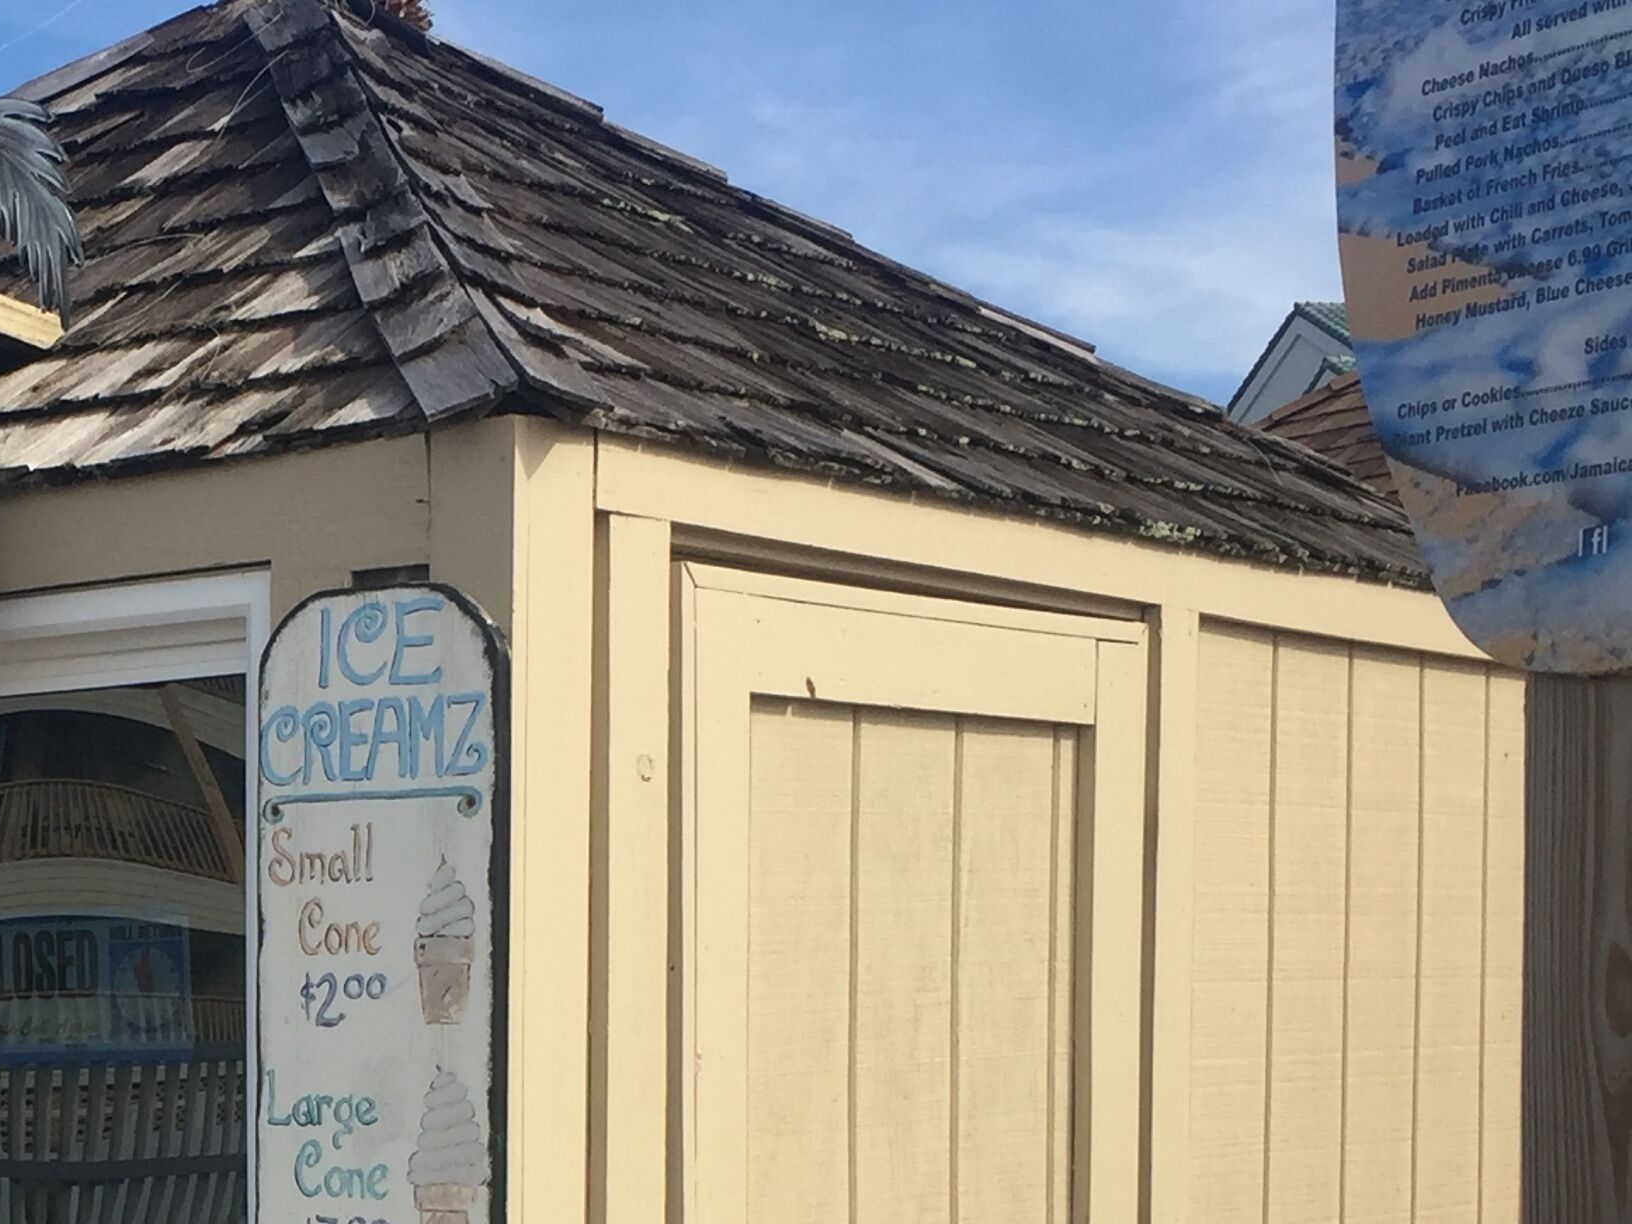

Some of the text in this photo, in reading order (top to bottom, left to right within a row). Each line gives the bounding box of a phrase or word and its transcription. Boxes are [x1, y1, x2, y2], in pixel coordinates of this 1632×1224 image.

[1460, 2, 1506, 25] Crispy
[1511, 18, 1532, 39] All
[1535, 2, 1588, 32] served
[1421, 70, 1475, 96] Cheese
[1432, 99, 1479, 122] Crispy
[1483, 85, 1523, 108] Chips
[1528, 72, 1556, 94] and
[1560, 59, 1609, 85] Queso
[1434, 127, 1466, 150] Peel
[1470, 120, 1497, 141] and
[1502, 112, 1527, 133] Eat
[1413, 191, 1462, 215] Basket
[1467, 184, 1481, 199] of
[1486, 169, 1536, 196] French
[1416, 159, 1461, 185] Pulled
[1465, 151, 1499, 171] Pork
[1397, 182, 1624, 247] Loaded with Chili and Cheese,
[1407, 251, 1446, 274] Salad
[1494, 232, 1526, 254] with
[1530, 218, 1594, 244] Carrots,
[1409, 281, 1437, 302] Add
[1442, 269, 1502, 295] Pimento
[1568, 244, 1601, 266] 6.99
[1415, 308, 1462, 330] Honey
[1465, 291, 1531, 319] Mustard,
[1536, 286, 1570, 305] Blue
[1584, 334, 1628, 354] Sides
[1397, 400, 1437, 420] Chips
[1442, 398, 1457, 412] or
[1436, 418, 1487, 443] Pretzel
[1491, 412, 1524, 433] with
[318, 596, 445, 689] ICE
[261, 691, 488, 787] CREAMZ
[268, 822, 374, 887] Small
[298, 897, 382, 956] Cone
[267, 1069, 378, 1149] Large
[294, 1139, 389, 1200] Cone
